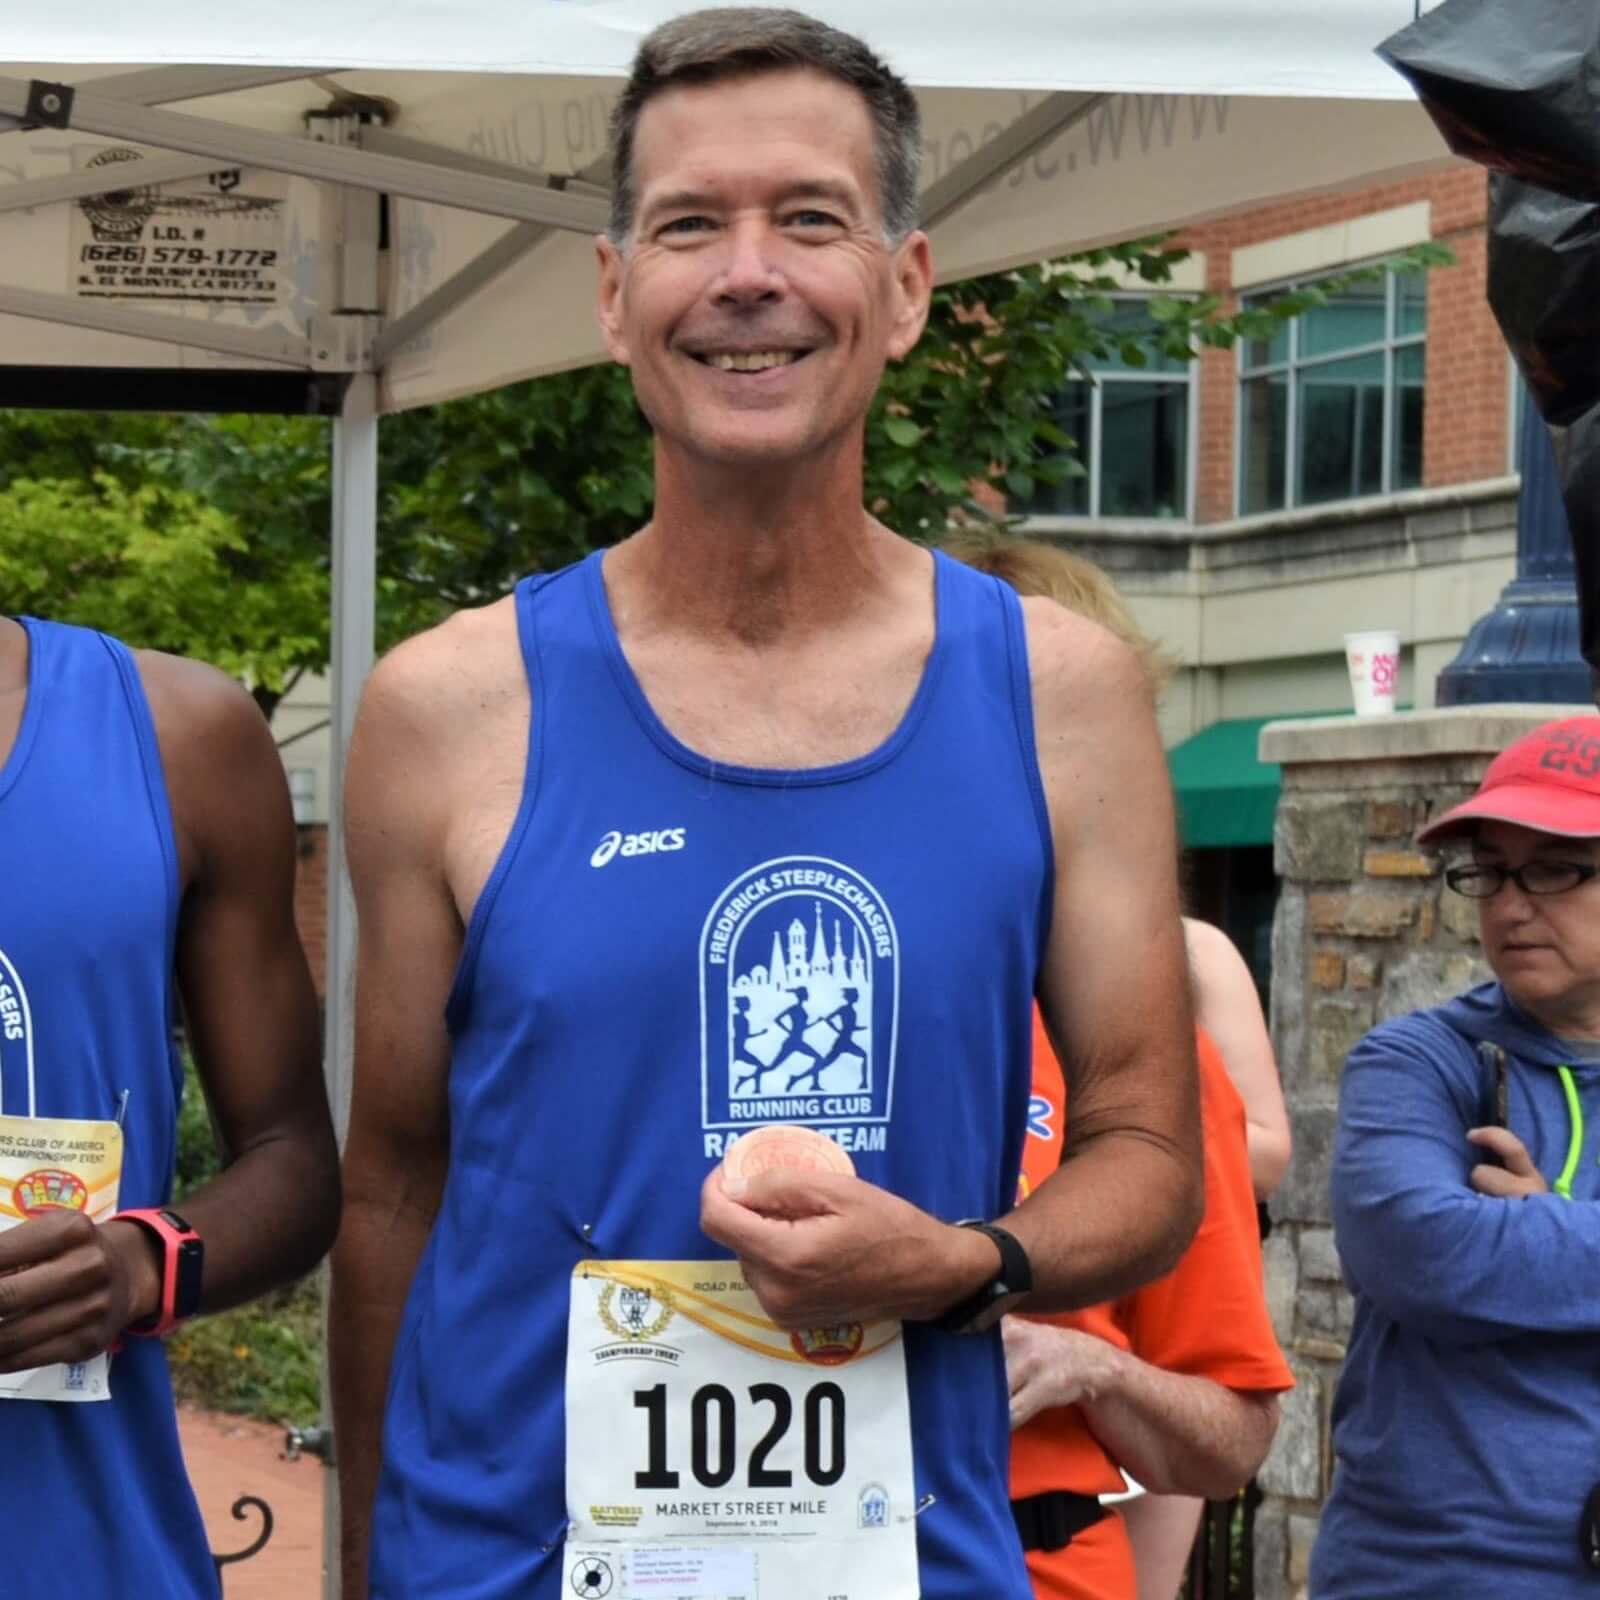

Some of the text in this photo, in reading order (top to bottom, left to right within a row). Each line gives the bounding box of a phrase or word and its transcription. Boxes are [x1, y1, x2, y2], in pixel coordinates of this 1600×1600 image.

[152, 247, 278, 266] 579-1772
[191, 279, 213, 289] CA
[620, 828, 686, 857] asics
[710, 869, 893, 964] FREDERICK STEEPLECHASERS
[729, 1097, 872, 1119] RUNNING CLUB
[16, 1136, 48, 1149] CLUB
[50, 1139, 64, 1149] OF
[78, 1153, 105, 1164] EVENT
[693, 1282, 726, 1292] ROAD
[633, 1381, 846, 1490] 1020
[656, 1501, 827, 1516] MARKET STREET MILE
